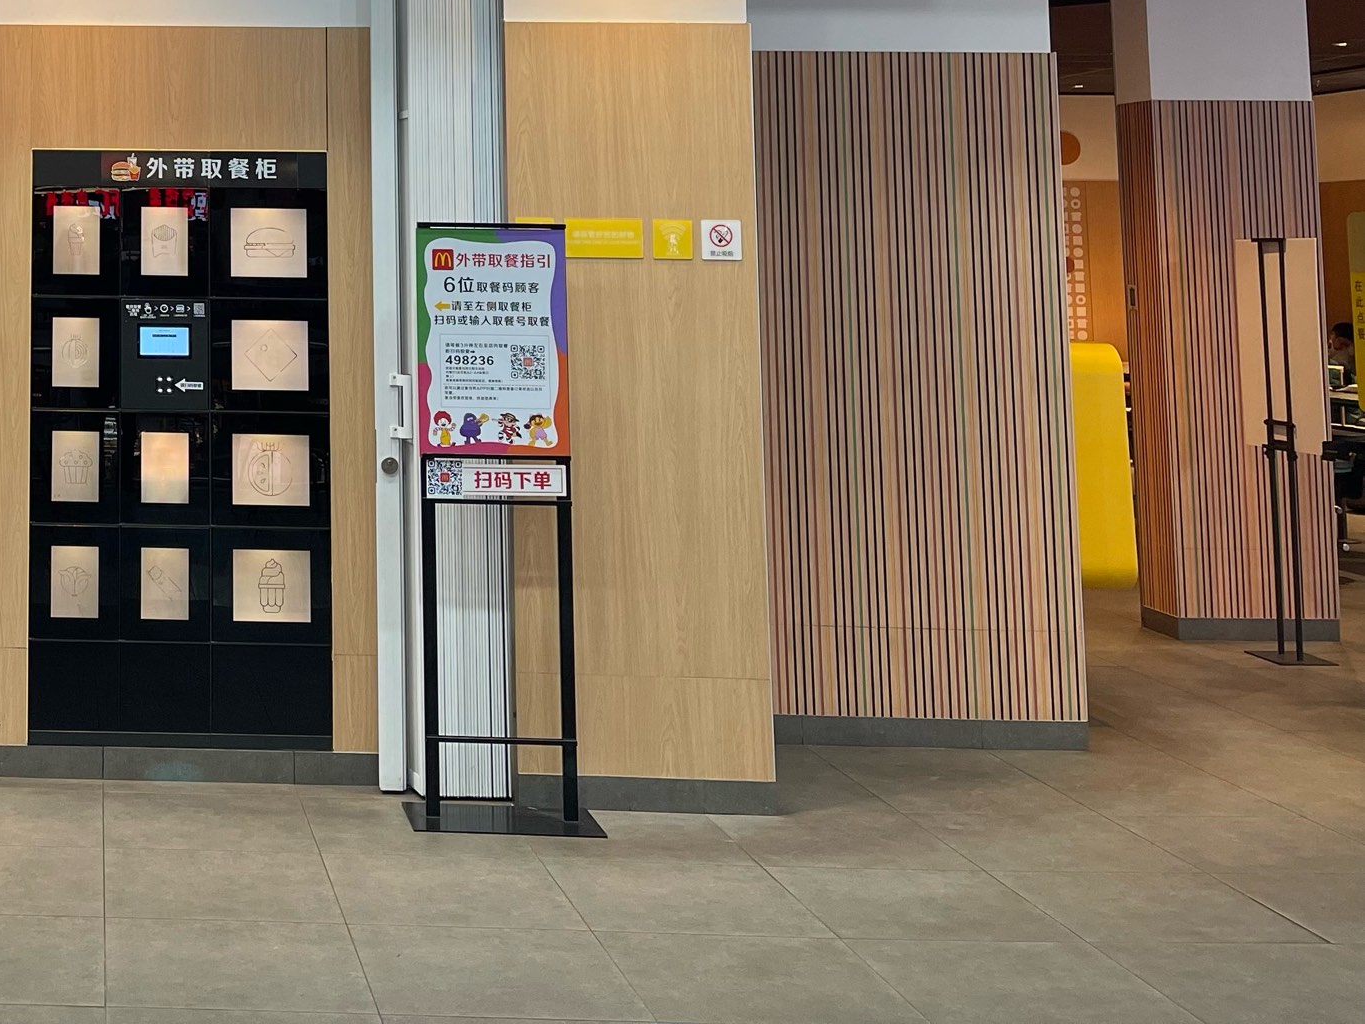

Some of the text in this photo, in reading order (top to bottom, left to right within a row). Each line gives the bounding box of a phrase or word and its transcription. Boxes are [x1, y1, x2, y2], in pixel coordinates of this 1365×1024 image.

[146, 157, 278, 180] 外带取餐柜
[455, 253, 551, 269] 外带取餐指引
[451, 301, 532, 312] 请至左侧取餐柜
[434, 315, 550, 327] 扫码或输入取餐号取餐
[445, 355, 495, 366] 498236
[474, 470, 552, 490] 扫码下单
